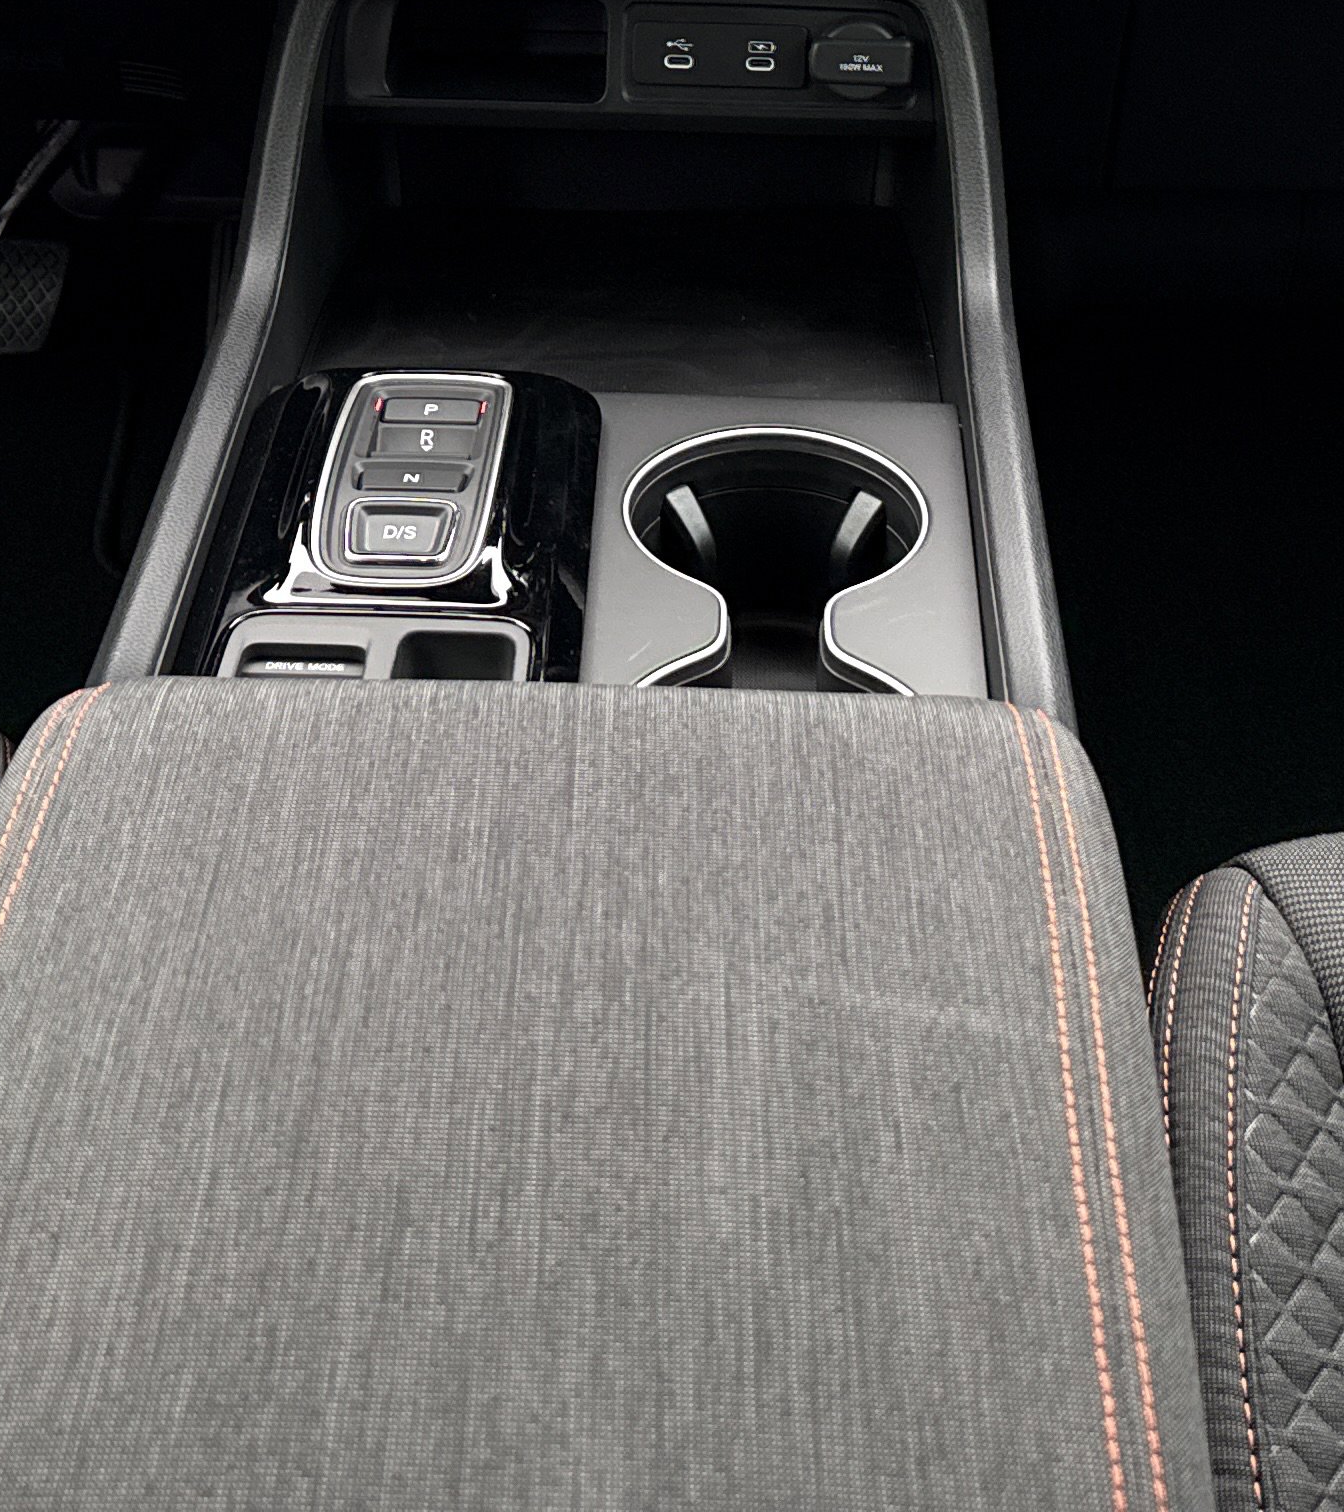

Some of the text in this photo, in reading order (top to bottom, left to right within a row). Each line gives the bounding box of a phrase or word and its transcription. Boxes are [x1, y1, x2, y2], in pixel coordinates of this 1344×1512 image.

[852, 54, 870, 63] 12V
[862, 63, 883, 73] MAX
[423, 403, 439, 416] P
[419, 429, 434, 446] R
[402, 473, 420, 483] N
[382, 524, 417, 539] D/S
[265, 661, 345, 672] DRIVE MODE
